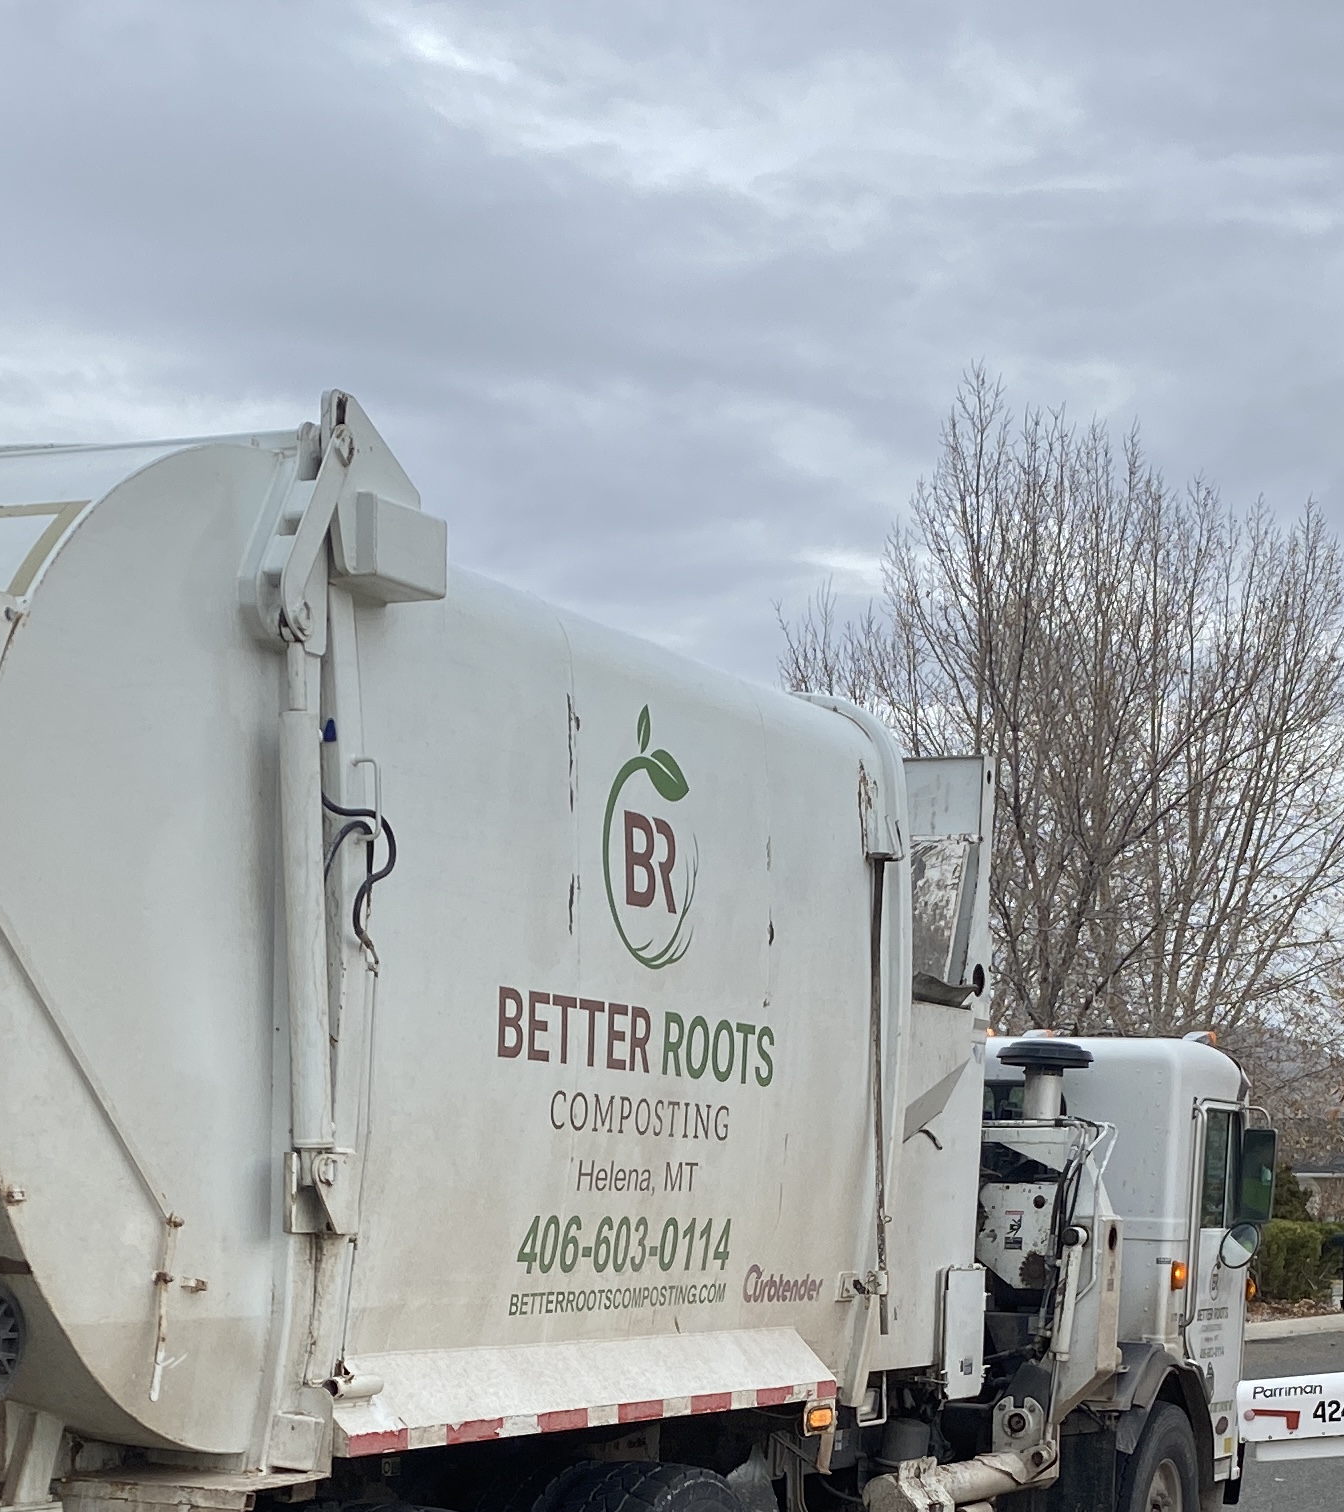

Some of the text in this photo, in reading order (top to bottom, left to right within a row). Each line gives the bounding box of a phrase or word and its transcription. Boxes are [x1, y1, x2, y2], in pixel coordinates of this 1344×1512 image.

[623, 809, 677, 914] BR
[497, 985, 775, 1087] BETTER ROOTS
[550, 1090, 730, 1141] COMPOSTING
[576, 1159, 699, 1196] Helena, MT
[517, 1215, 732, 1274] 406-603-0114
[508, 1283, 727, 1316] BETTERROOTSCOMPOSTING.COM
[742, 1264, 824, 1303] Curbtender
[1252, 1384, 1323, 1400] Parriman
